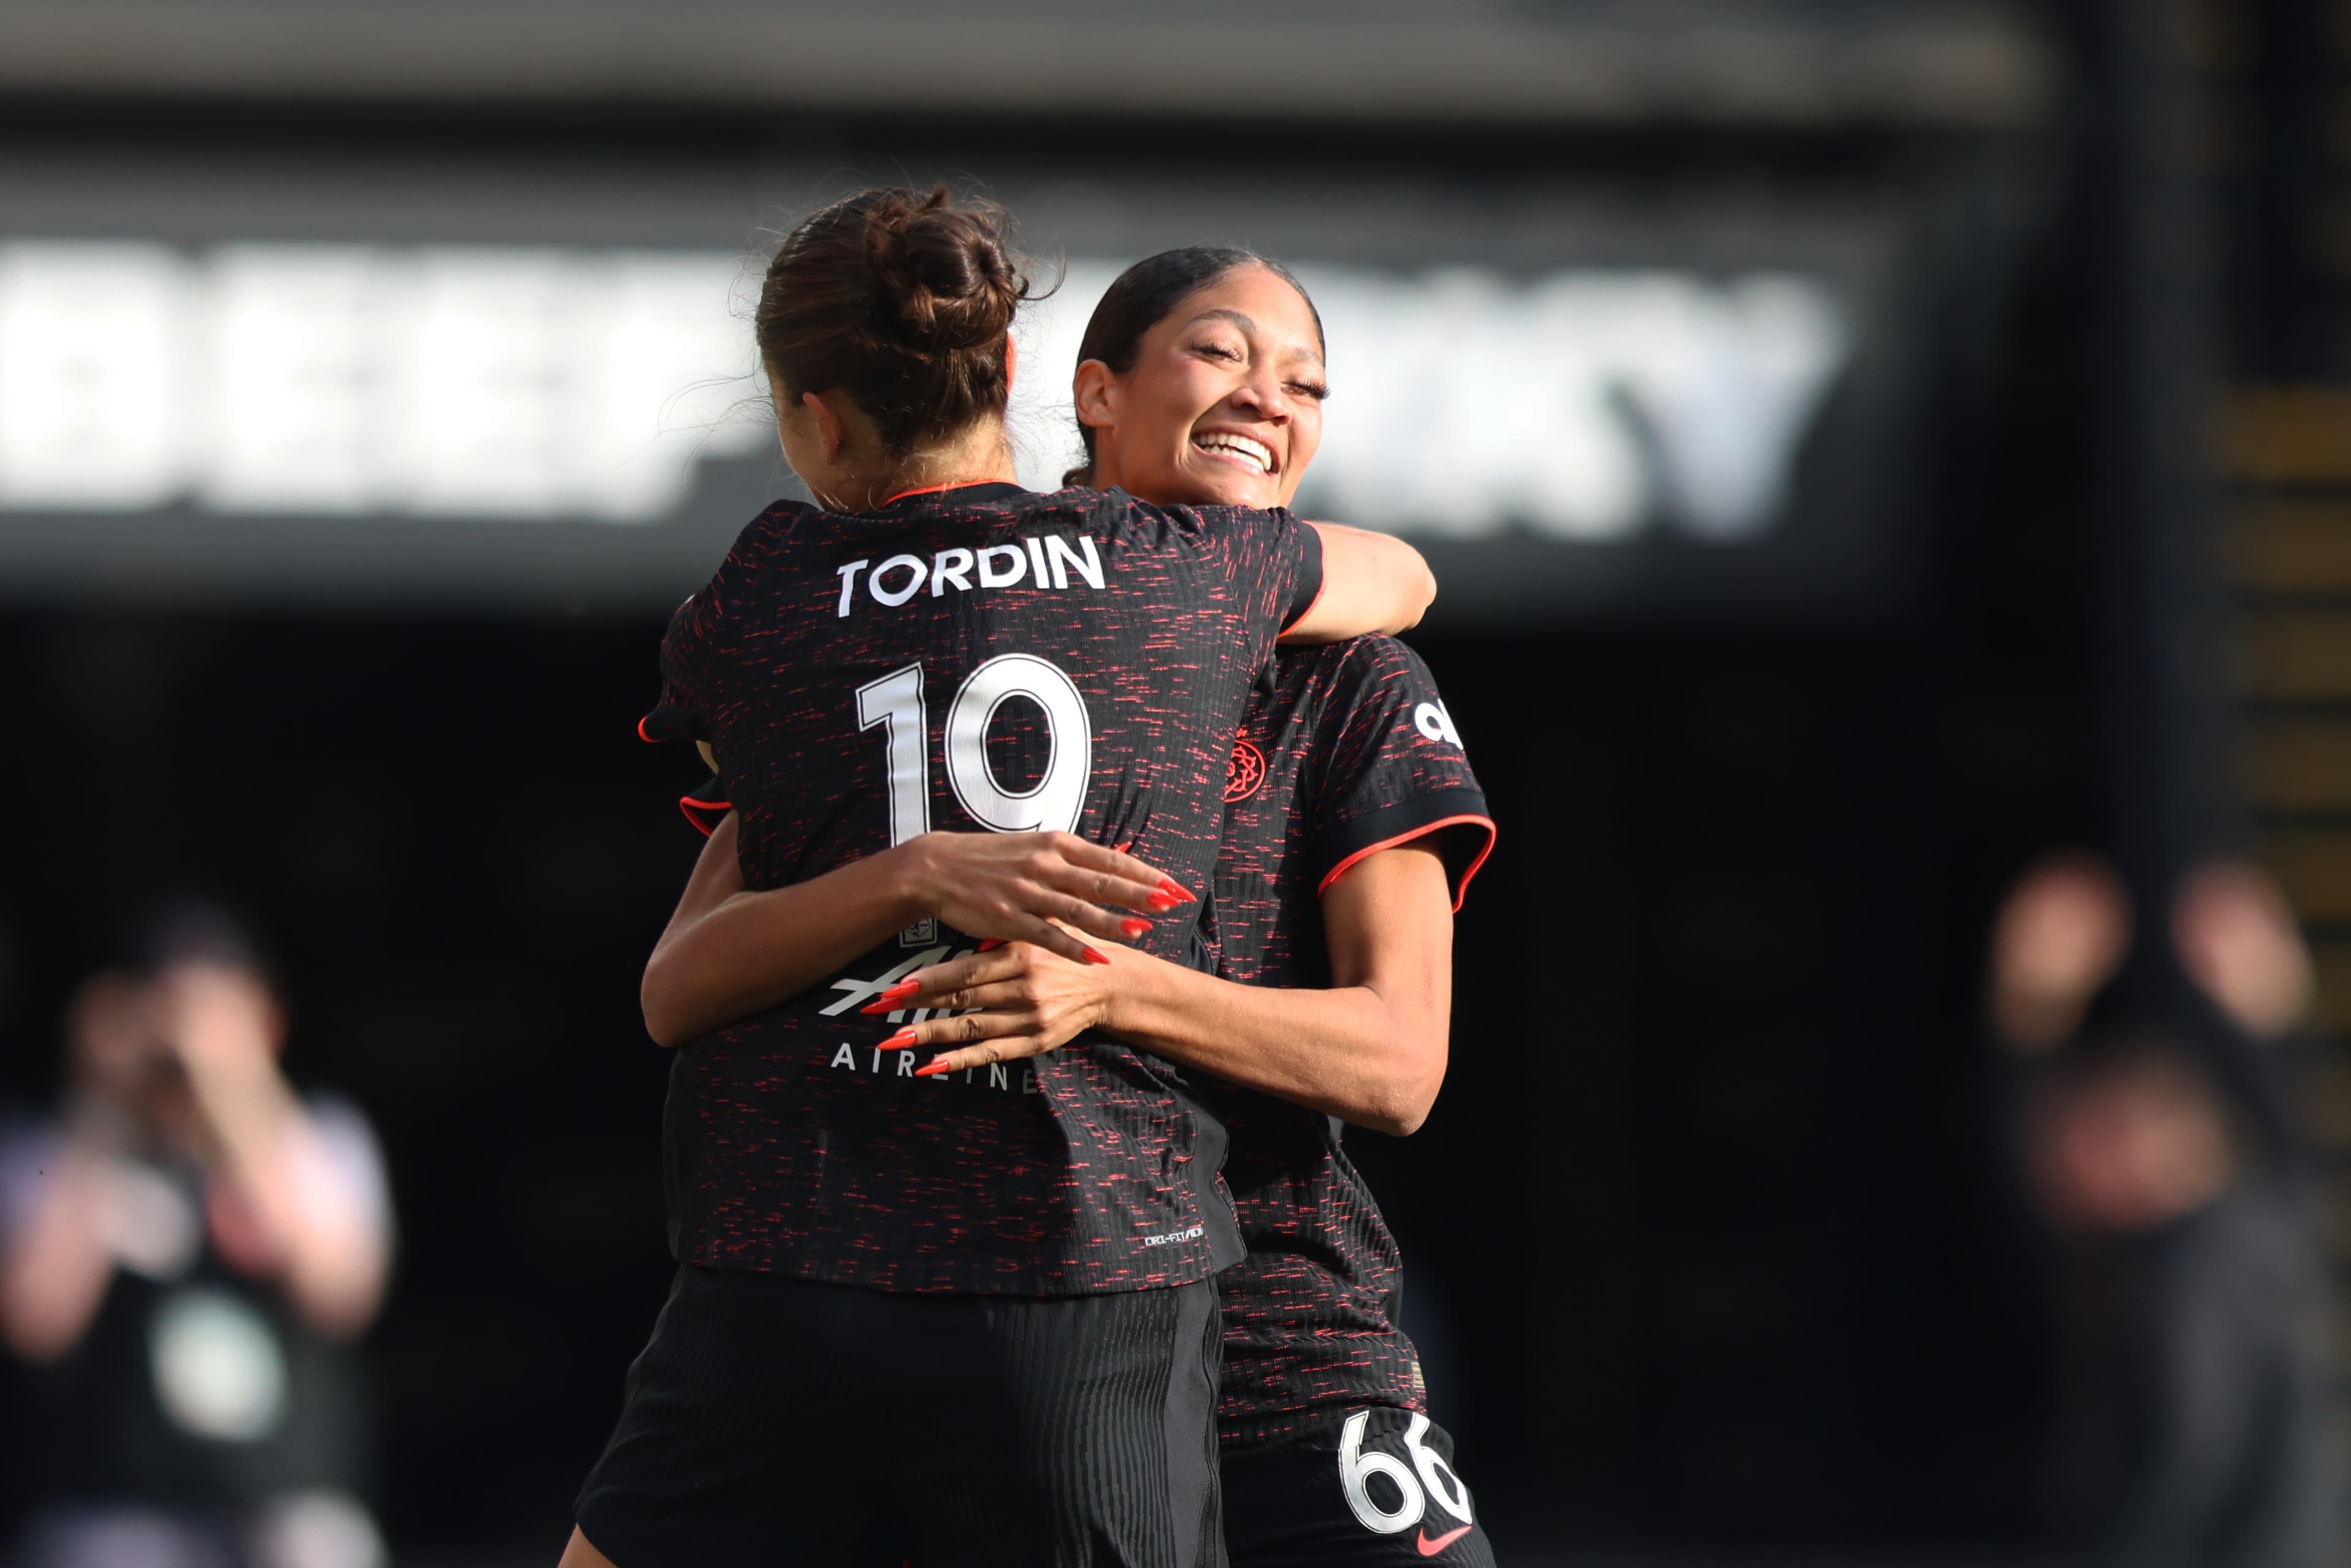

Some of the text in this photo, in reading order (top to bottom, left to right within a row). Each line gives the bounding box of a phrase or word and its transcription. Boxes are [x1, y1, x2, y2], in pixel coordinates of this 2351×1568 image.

[837, 535, 1105, 617] TORDIN
[856, 653, 1092, 849] 19
[1338, 1410, 1472, 1533] 66
